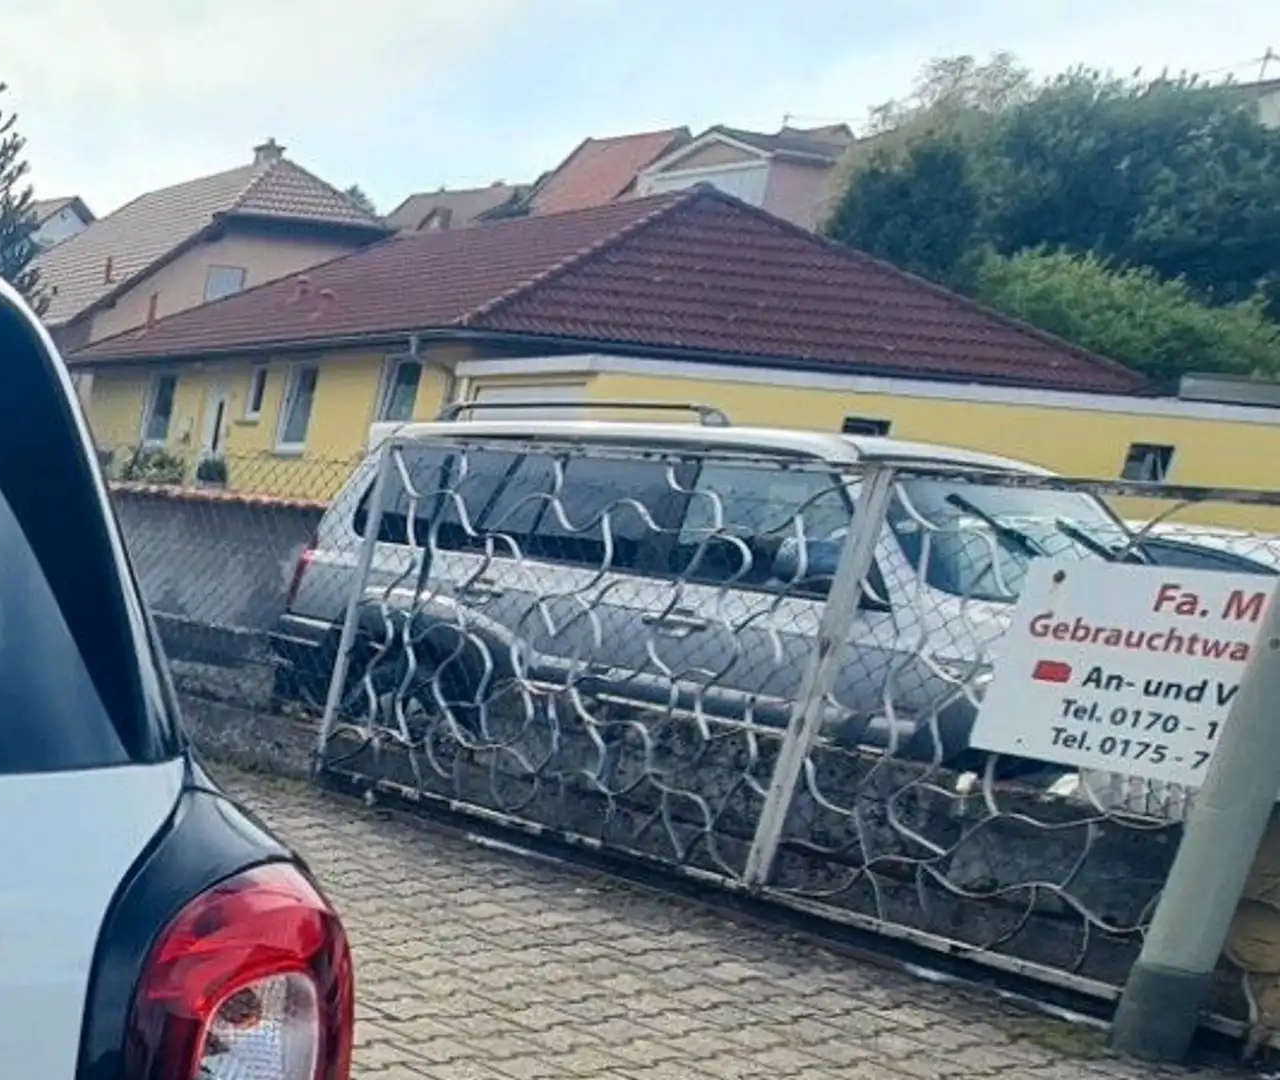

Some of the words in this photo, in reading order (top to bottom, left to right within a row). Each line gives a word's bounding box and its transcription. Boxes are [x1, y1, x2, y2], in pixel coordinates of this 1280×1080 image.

[1152, 583, 1210, 617] Fa.
[1221, 590, 1266, 623] M
[1028, 611, 1251, 662] Gebrauchtwa
[1081, 666, 1136, 692] An-
[1143, 677, 1206, 703] und
[1215, 683, 1239, 707] V
[1061, 699, 1103, 723] Tel.
[1109, 707, 1179, 734] 0170
[1206, 721, 1219, 740] 1
[1050, 727, 1092, 752] Tel.
[1098, 736, 1168, 764] 0175
[1190, 751, 1210, 770] 7
